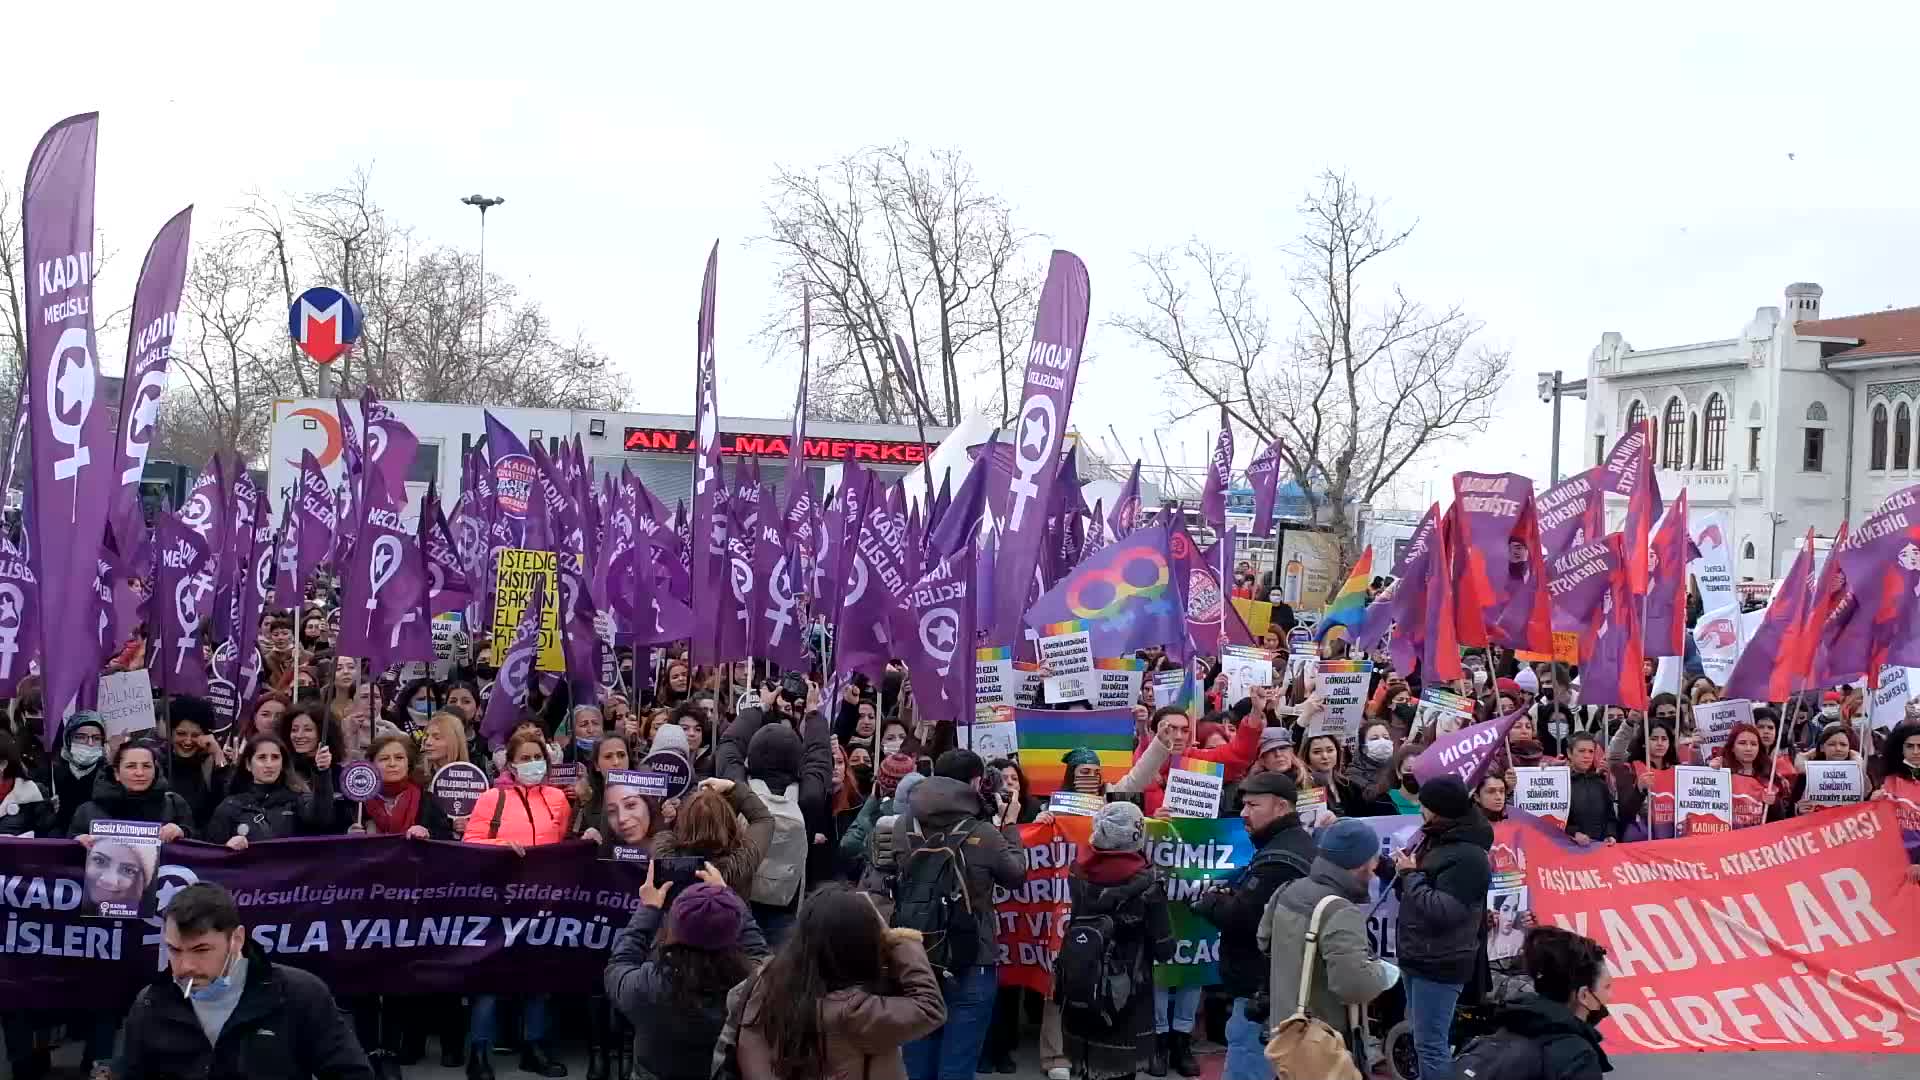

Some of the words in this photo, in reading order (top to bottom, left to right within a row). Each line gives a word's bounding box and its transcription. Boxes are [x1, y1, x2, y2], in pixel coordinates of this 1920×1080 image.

[39, 251, 92, 296] KADI
[803, 440, 934, 462] MERKE
[859, 527, 909, 598] CLİSLERİ
[651, 761, 680, 773] KADIN
[1719, 833, 1821, 875] ATAERKİYE
[1820, 810, 1882, 850] KARŞI
[0, 873, 82, 912] KAD
[596, 889, 642, 914] Gölg
[0, 912, 122, 960] İSLERİ
[249, 920, 330, 954] SLA
[341, 915, 493, 951] YALNIZ
[500, 910, 617, 951] YÜRÜ
